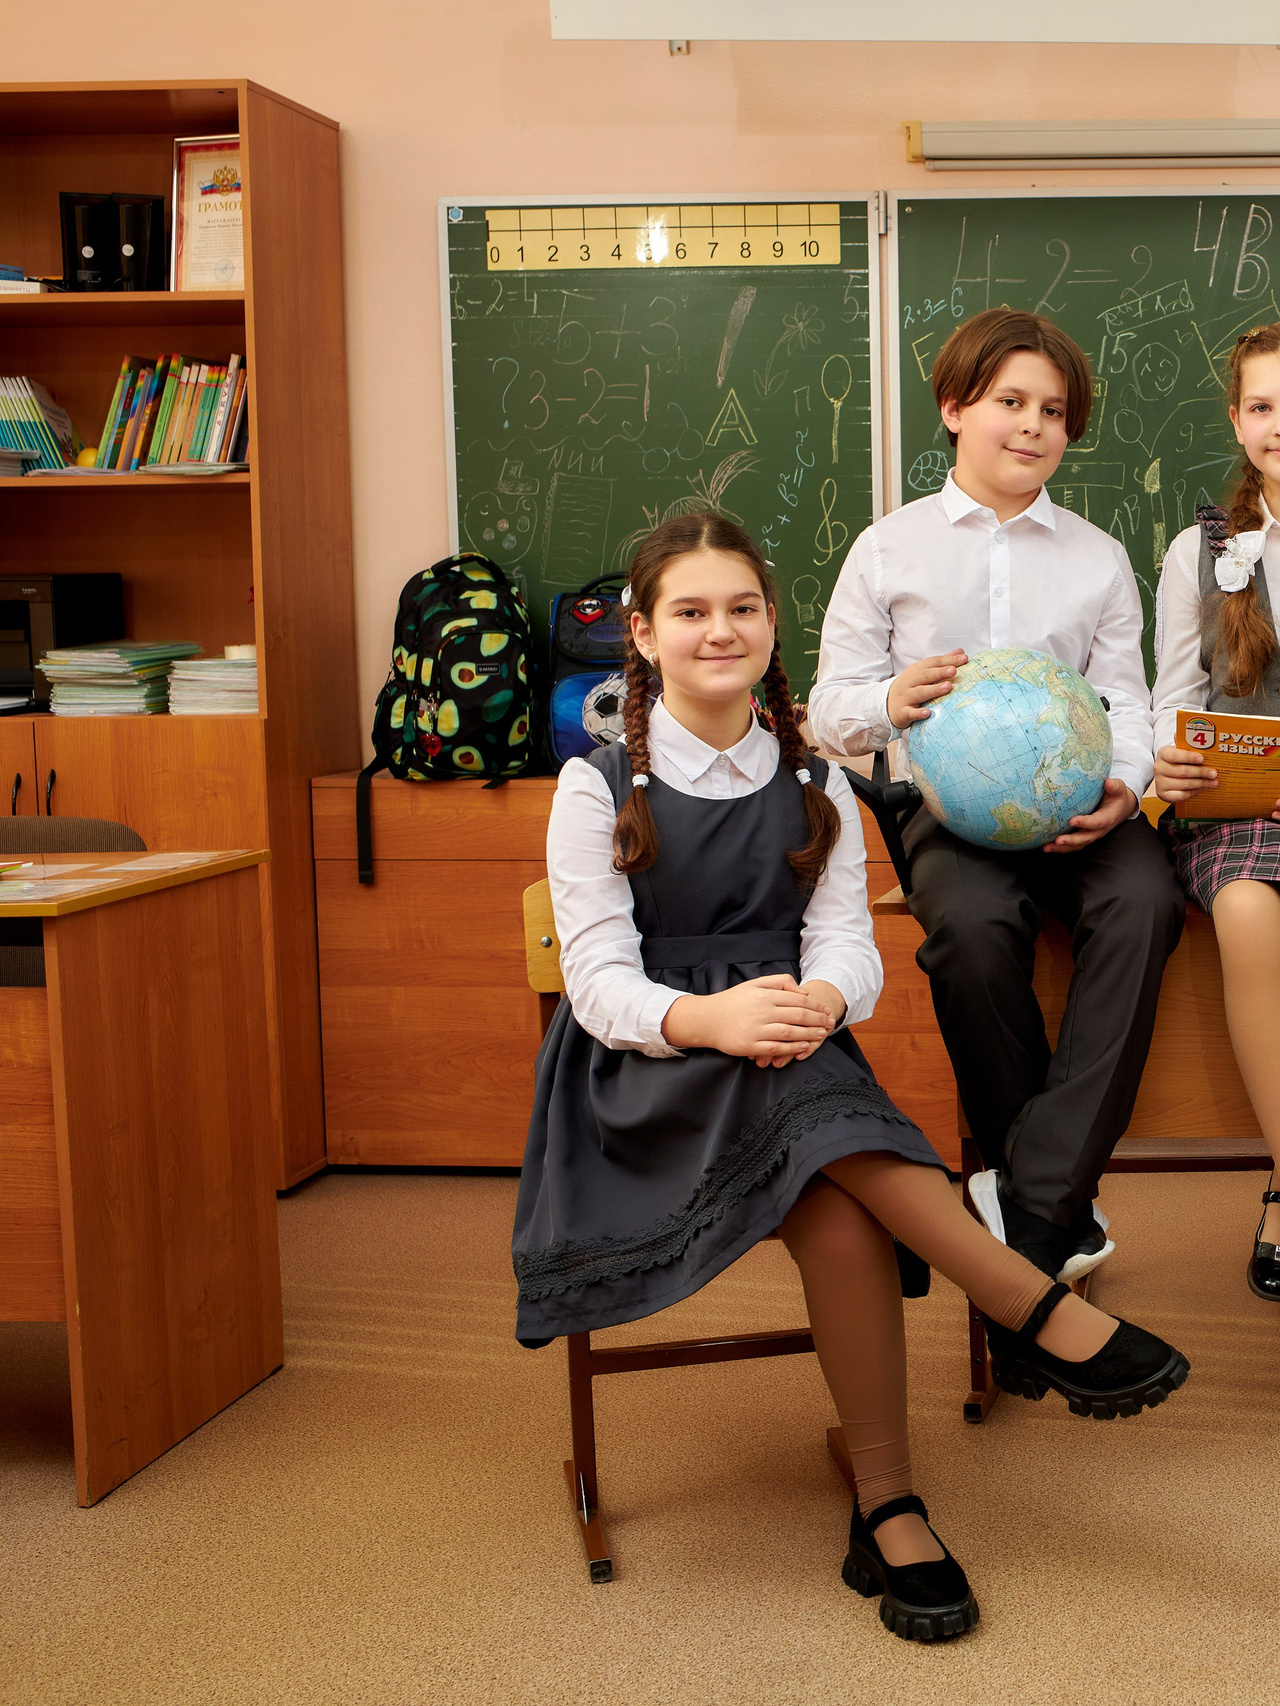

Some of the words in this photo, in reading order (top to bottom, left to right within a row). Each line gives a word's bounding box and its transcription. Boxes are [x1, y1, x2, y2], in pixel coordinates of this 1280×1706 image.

[490, 246, 500, 263] 0
[517, 246, 524, 262] 1
[547, 246, 559, 262] 2
[579, 246, 590, 262] 3
[611, 245, 623, 260] 4
[675, 244, 686, 260] 6
[708, 243, 718, 259] 7
[740, 243, 751, 259] 8
[772, 242, 783, 258] 9
[799, 241, 819, 258] 10
[1192, 732, 1207, 746] 4
[1218, 743, 1266, 756] ЯЗЫК
